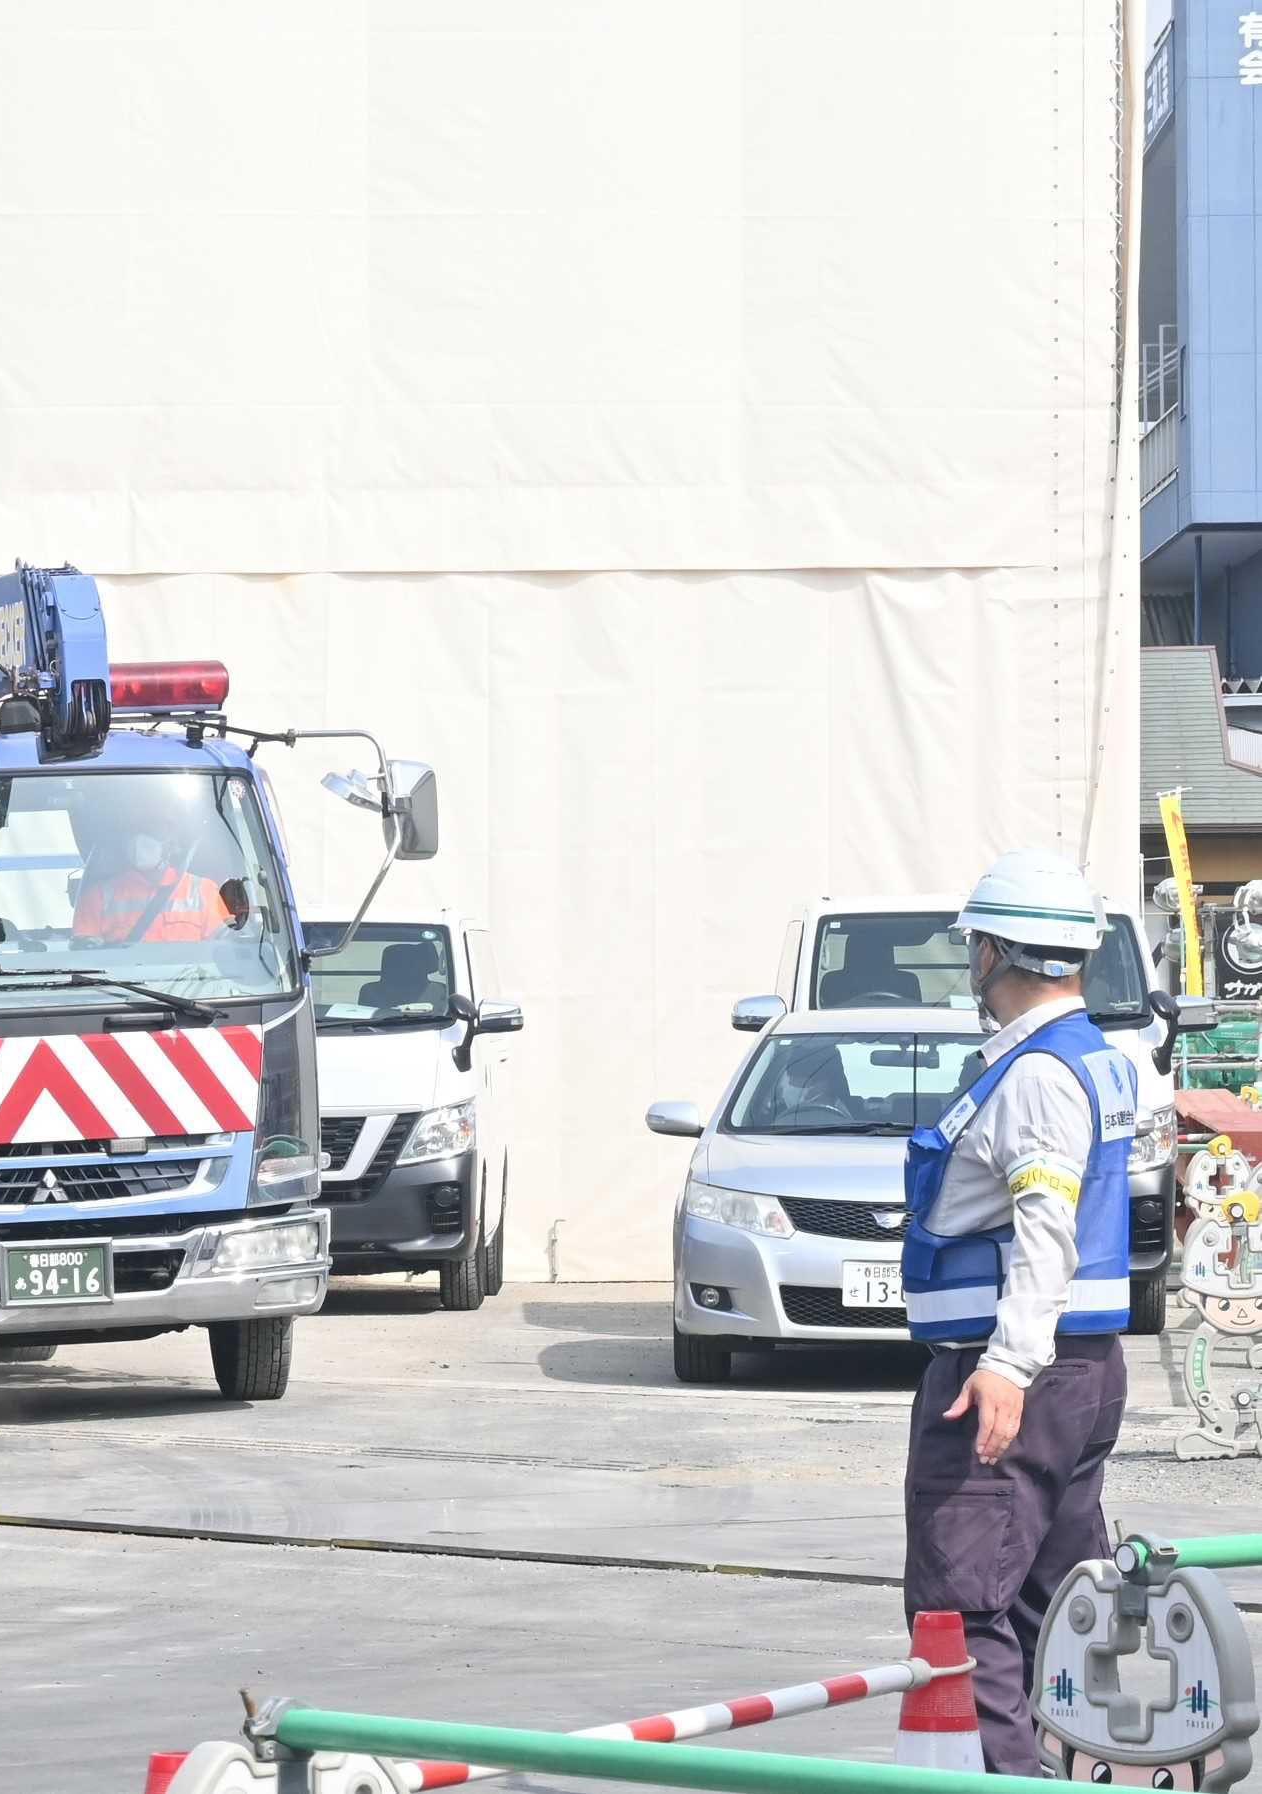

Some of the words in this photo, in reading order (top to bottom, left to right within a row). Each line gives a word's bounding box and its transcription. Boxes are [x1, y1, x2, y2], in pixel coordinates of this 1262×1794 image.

[29, 1267, 100, 1295] 94-16
[1051, 1707, 1079, 1718] TAISEI
[1185, 1719, 1215, 1730] TAISEI
